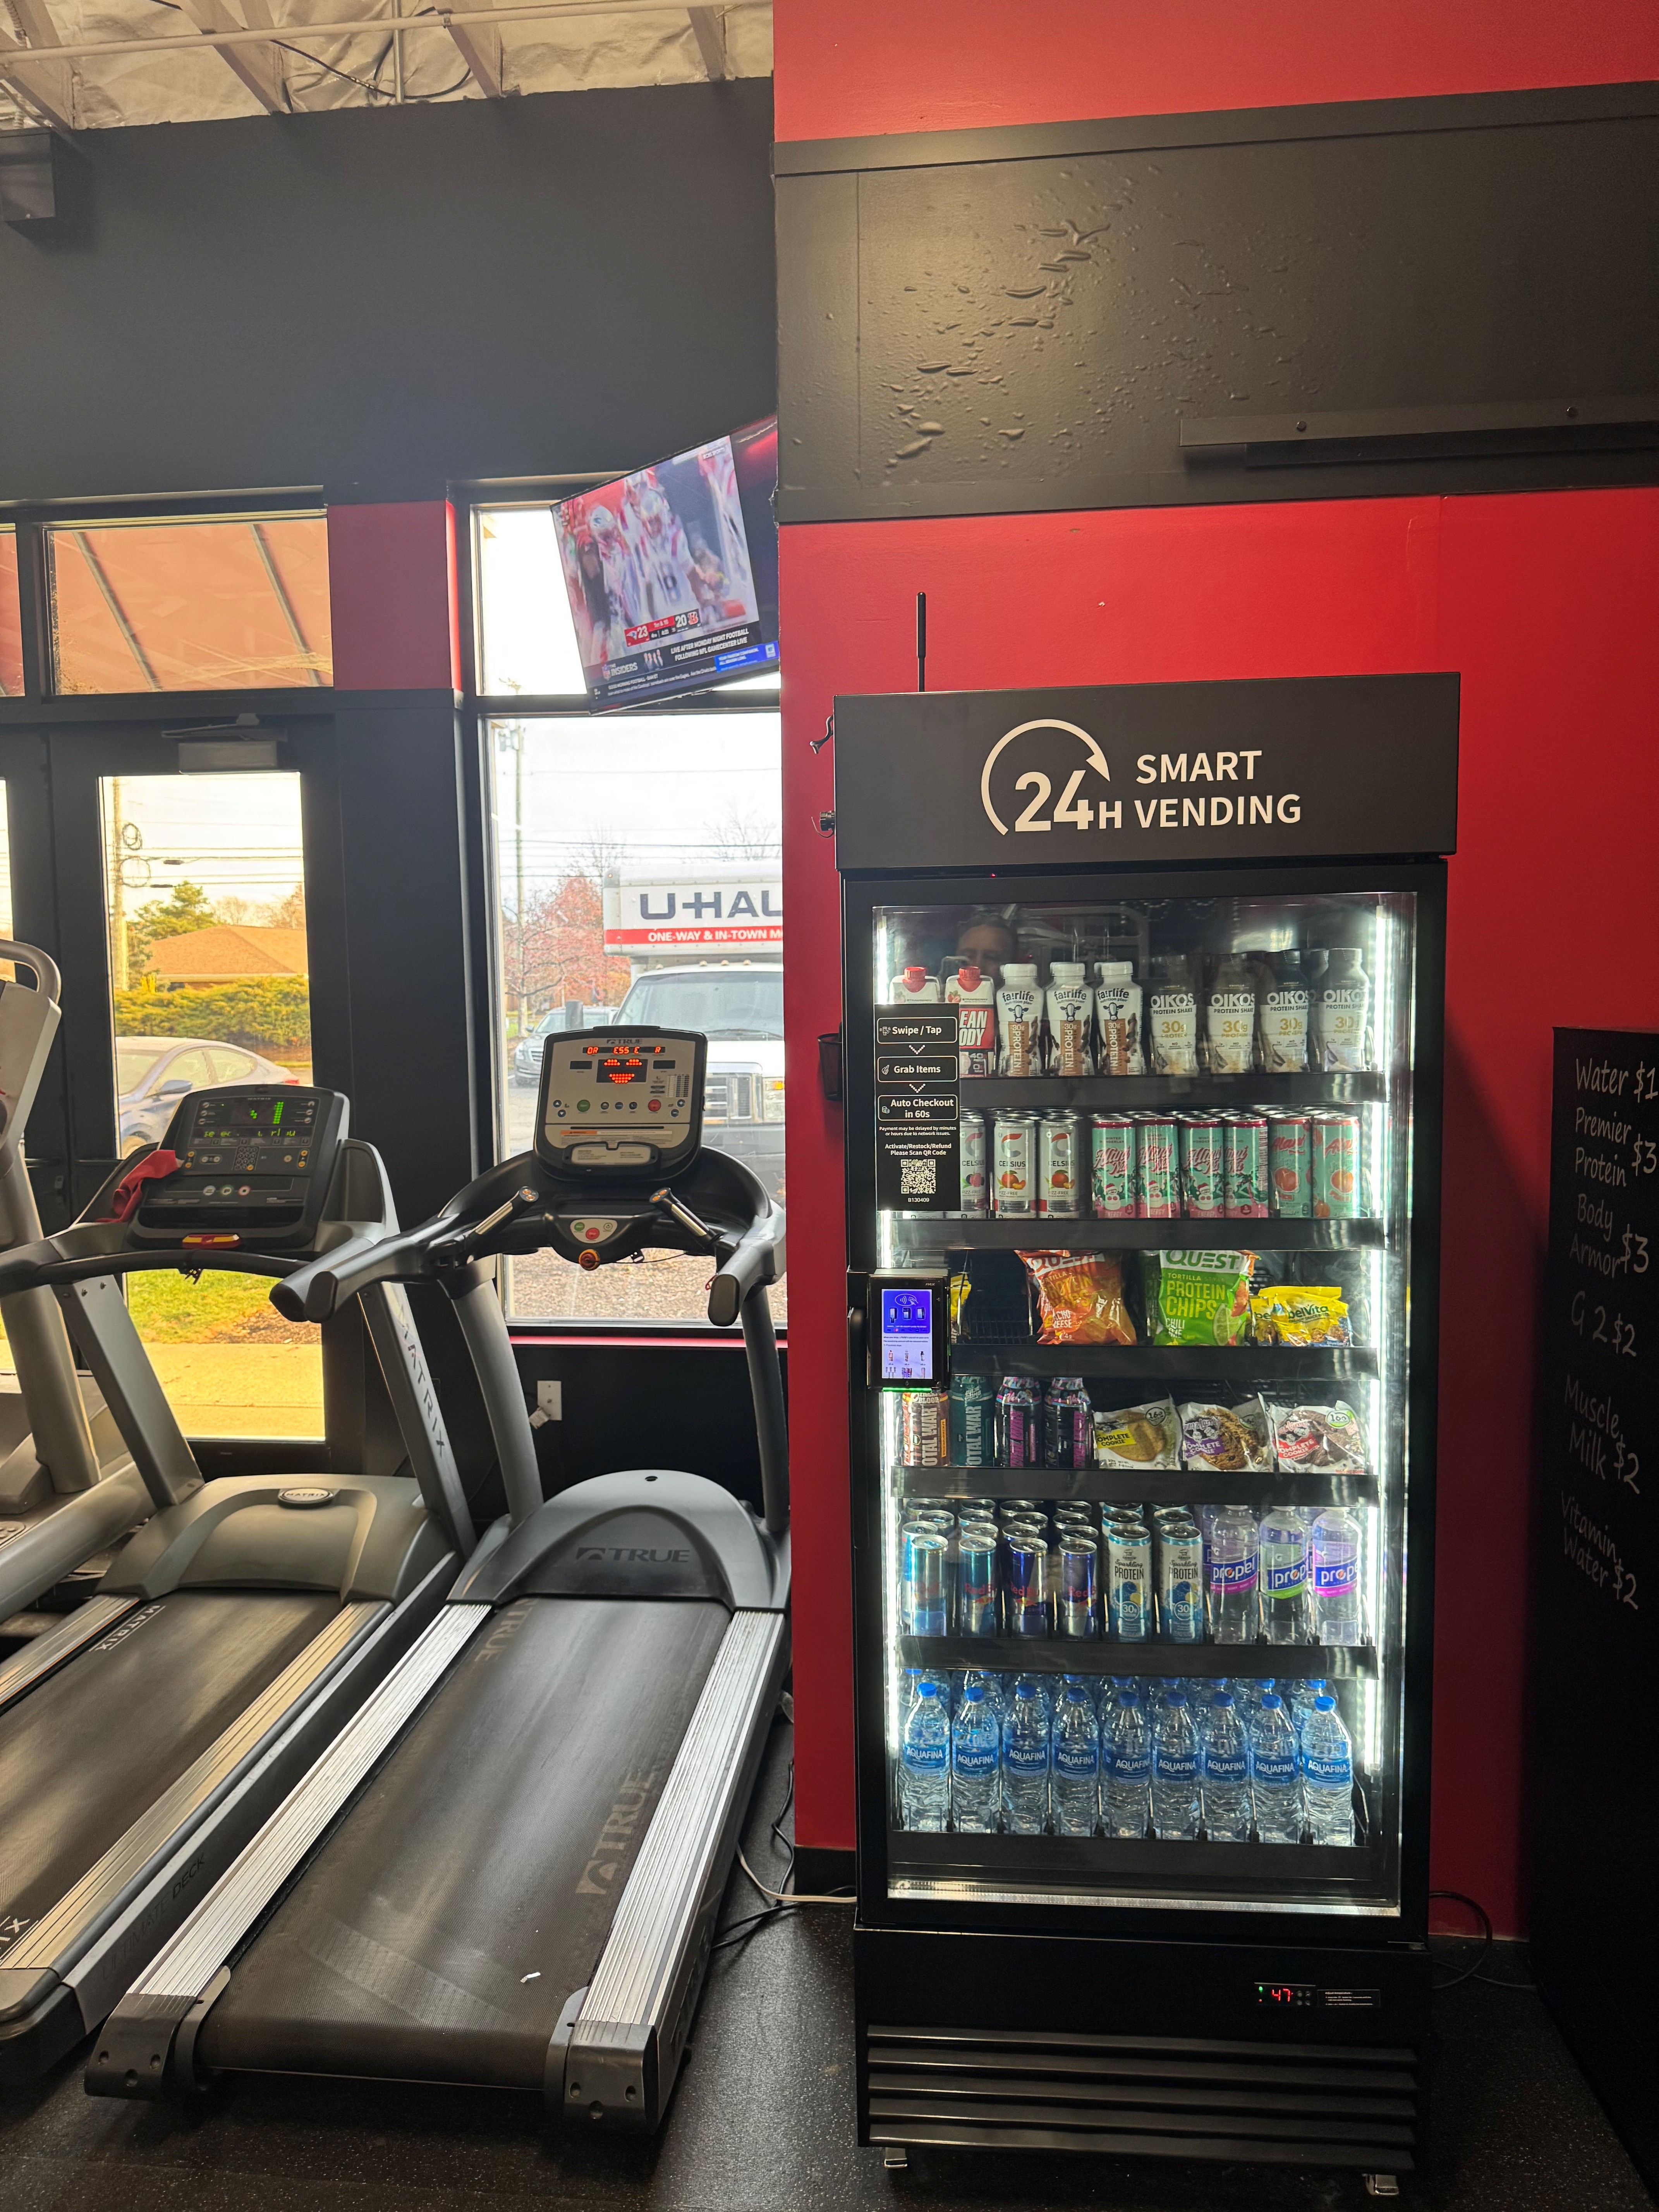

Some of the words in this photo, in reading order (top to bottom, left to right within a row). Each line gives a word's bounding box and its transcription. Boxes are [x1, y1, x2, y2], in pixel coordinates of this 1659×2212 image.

[675, 614, 687, 628] 20
[637, 625, 648, 639] 23
[680, 643, 694, 651] AFTER
[726, 628, 749, 639] FOOTBALL
[737, 637, 748, 646] LIVE
[611, 662, 638, 677] INSIDERS
[1136, 750, 1262, 784] SMART
[1015, 769, 1122, 832] 24H
[1134, 793, 1301, 828] VENDING
[640, 890, 783, 920] U-HAU
[648, 931, 701, 942] ONE-WAY
[703, 930, 713, 940] &
[715, 929, 767, 940] IN-TOWN
[1151, 993, 1194, 1008] OIKOS
[1211, 993, 1255, 1007] OIKOS
[1323, 989, 1366, 1003] OIKO
[959, 1011, 988, 1028] EAN
[892, 1026, 919, 1036] Swipe
[920, 1025, 924, 1036] /
[926, 1026, 942, 1036] Tap
[959, 1028, 985, 1046] ODY
[1013, 1030, 1022, 1068] PROTEIN
[1065, 1030, 1073, 1068] PROTEIN
[1108, 1029, 1118, 1067] PROTEIN
[894, 1065, 915, 1073] Grab
[916, 1065, 941, 1073] Items
[1576, 1058, 1629, 1096] Water
[1633, 1061, 1658, 1103] $1
[913, 1098, 954, 1107] Checkout
[905, 1110, 914, 1118] in
[915, 1110, 930, 1118] 60s
[1575, 1106, 1632, 1145] Premier
[1575, 1147, 1626, 1187] Protein
[1631, 1133, 1657, 1176] $3
[1577, 1193, 1613, 1242] Body
[1570, 1233, 1622, 1279] Armor
[1620, 1223, 1649, 1274] $3
[1165, 1250, 1240, 1270] QUEST
[1168, 1273, 1201, 1281] TORTILLA
[1166, 1280, 1226, 1301] PROTEIN
[1053, 1309, 1071, 1320] ACHO
[1166, 1296, 1217, 1320] CHIPS
[1287, 1304, 1329, 1319] belVita
[1166, 1318, 1185, 1329] CHILI
[1612, 1313, 1637, 1357] $2
[1564, 1373, 1619, 1439] Muscle
[921, 1407, 938, 1436] WAR
[965, 1406, 982, 1435] WAR
[1097, 1433, 1130, 1442] OMPLETE
[921, 1437, 938, 1466] OTAL
[966, 1436, 982, 1465] OTAL
[1278, 1439, 1314, 1454] OMPLETE
[1283, 1448, 1309, 1458] COOKIE
[1569, 1421, 1606, 1481] Milk
[1613, 1433, 1640, 1494] $2
[1561, 1489, 1617, 1563] Vitamin
[607, 1547, 690, 1563] TRUE
[1170, 1559, 1197, 1567] Sparkling
[1115, 1559, 1143, 1568] Sparkling
[1213, 1557, 1255, 1581] propel
[1564, 1527, 1609, 1588] Water
[1613, 1558, 1638, 1610] $2
[1115, 1566, 1144, 1580] PROTEIN
[1169, 1566, 1198, 1580] PROTEIN
[1274, 1563, 1306, 1588] prop
[1321, 1563, 1358, 1585] prope
[95, 1605, 161, 1651] MATRIX
[474, 1607, 533, 1662] TRUE
[906, 1747, 943, 1760] AQUAFINA
[957, 1754, 994, 1767] AQUAFINA
[1009, 1749, 1045, 1762] AQUAFINA
[1058, 1752, 1095, 1766] AQUAFINA
[1158, 1759, 1197, 1772] AQUAFINA
[1207, 1759, 1245, 1772] AQUAFINA
[1255, 1761, 1295, 1774] AQUAFINA
[1308, 1760, 1349, 1774] AQUAFINA
[592, 1772, 655, 1858] TRUE
[173, 1853, 206, 1899] DECK
[1272, 1988, 1290, 2002] 47
